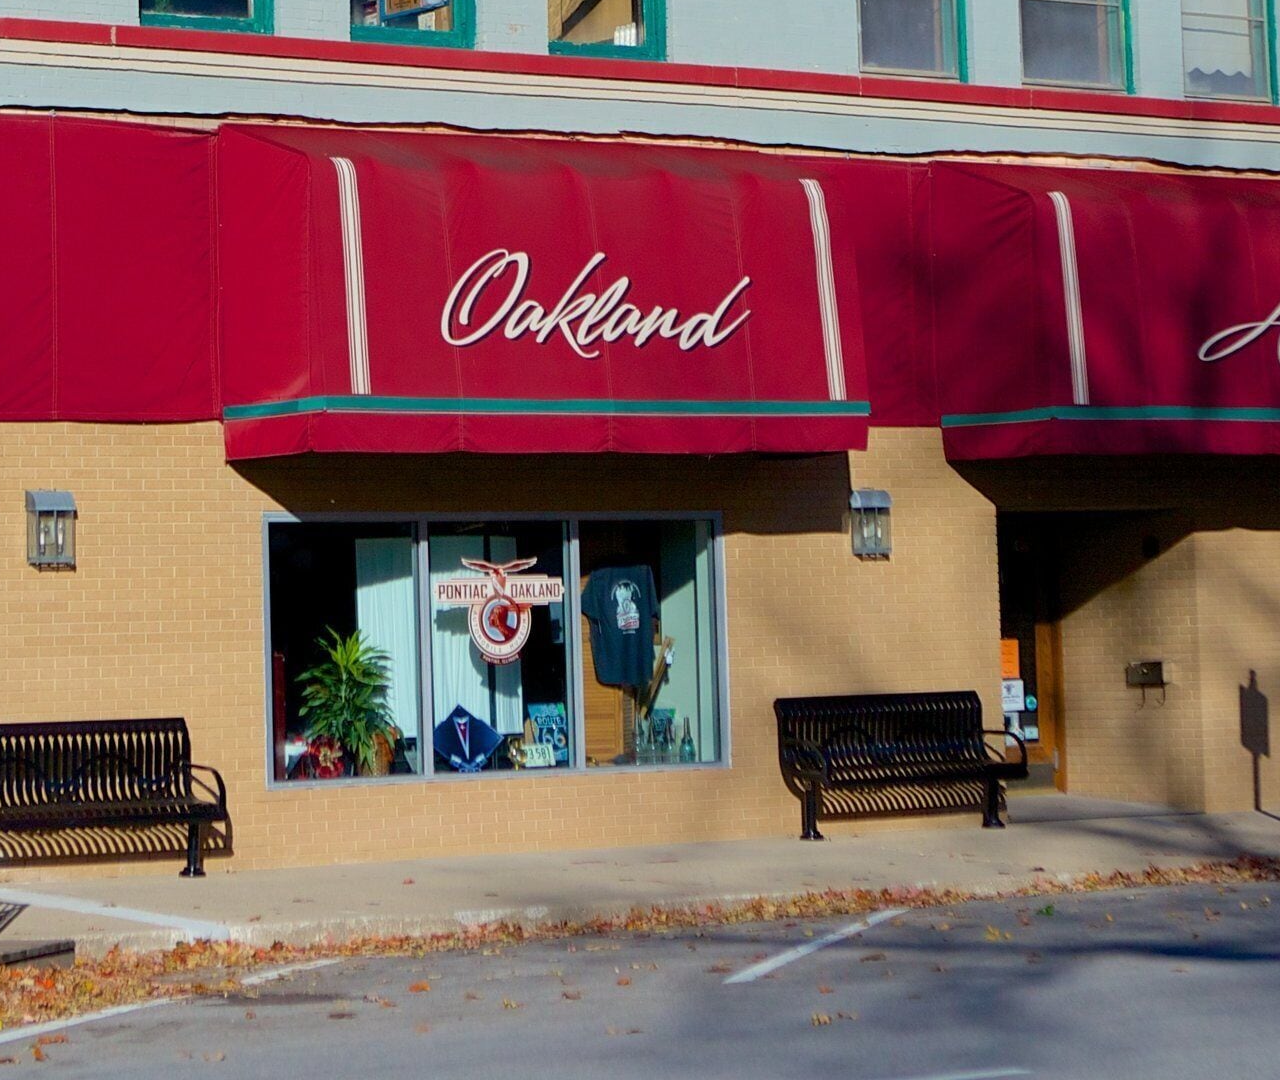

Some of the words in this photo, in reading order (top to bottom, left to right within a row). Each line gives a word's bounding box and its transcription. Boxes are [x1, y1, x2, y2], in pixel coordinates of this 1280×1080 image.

[441, 248, 751, 359] Oakland
[438, 584, 488, 599] PONTIAC
[510, 582, 560, 599] OAKLAND
[536, 716, 562, 725] ROUTE
[542, 727, 567, 748] 66
